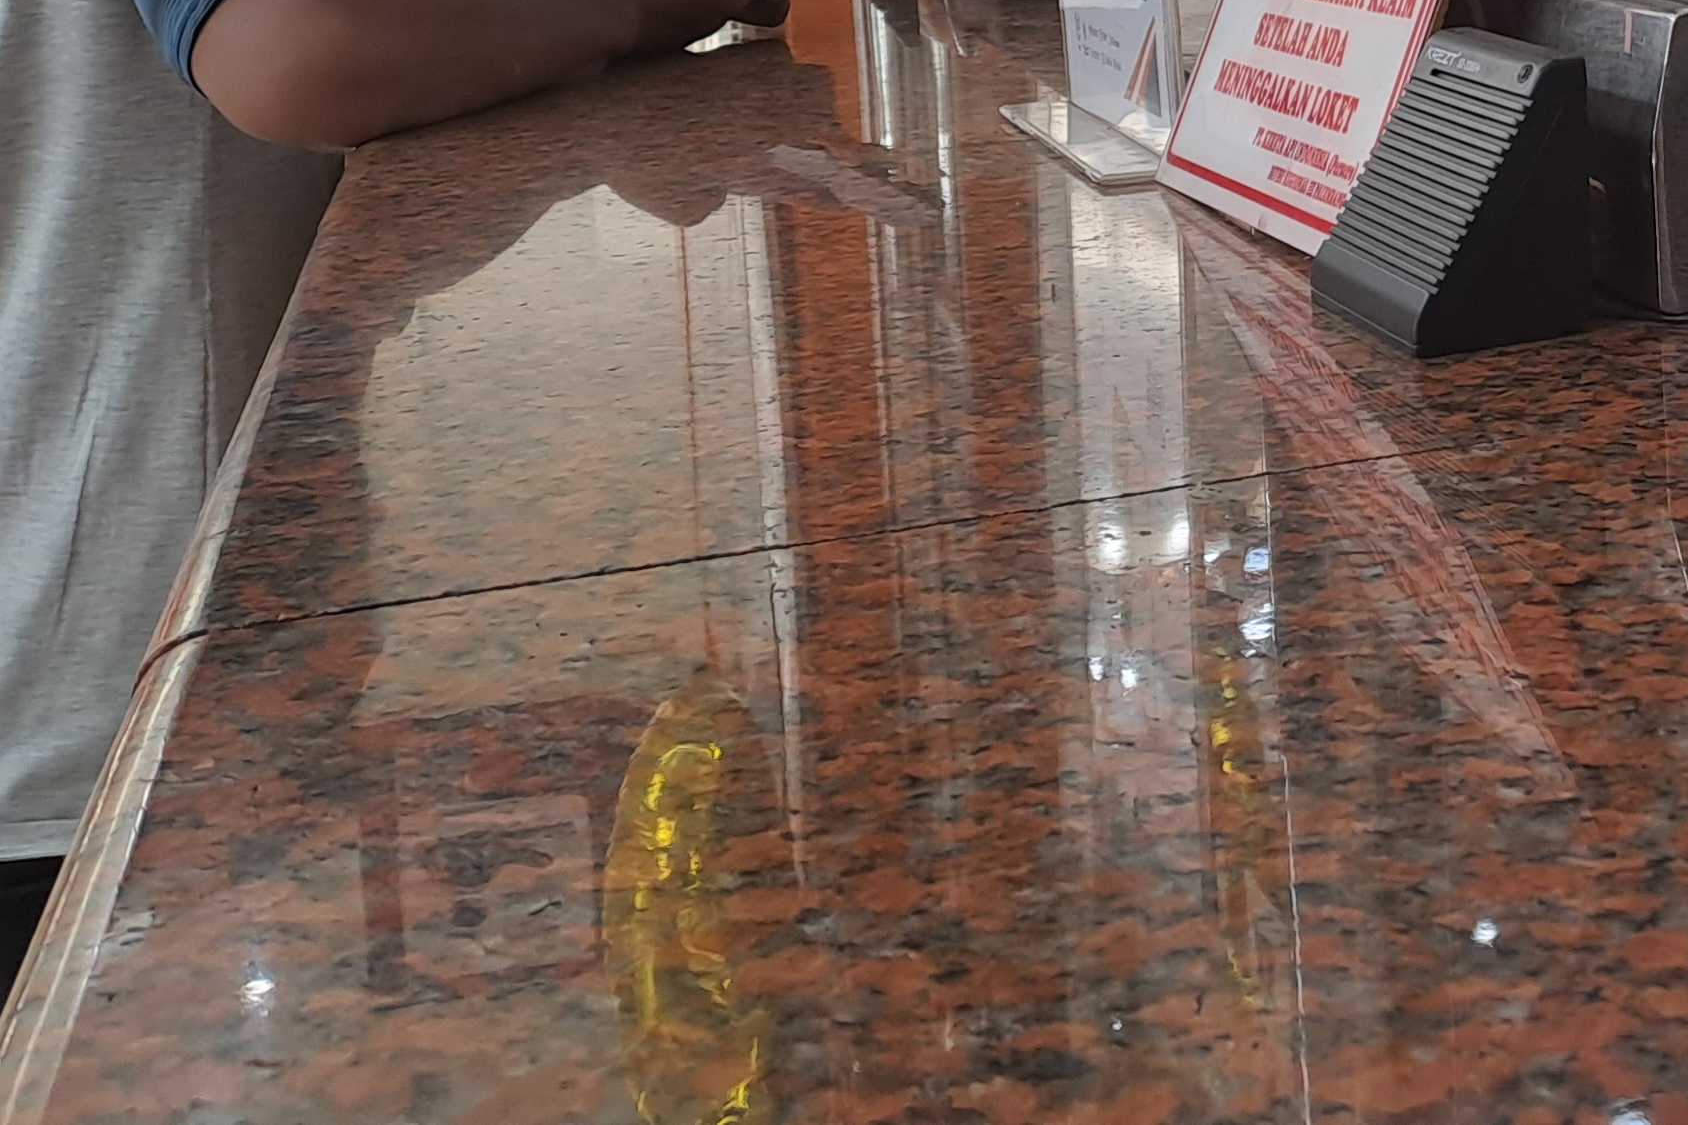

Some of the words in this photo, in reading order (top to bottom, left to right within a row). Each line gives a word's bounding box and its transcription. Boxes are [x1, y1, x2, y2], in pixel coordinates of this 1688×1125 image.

[1253, 12, 1314, 57] SETELAH
[1306, 24, 1350, 68] ANDA
[1213, 58, 1315, 119] MENINGGALKAN
[1307, 86, 1360, 134] LOKET
